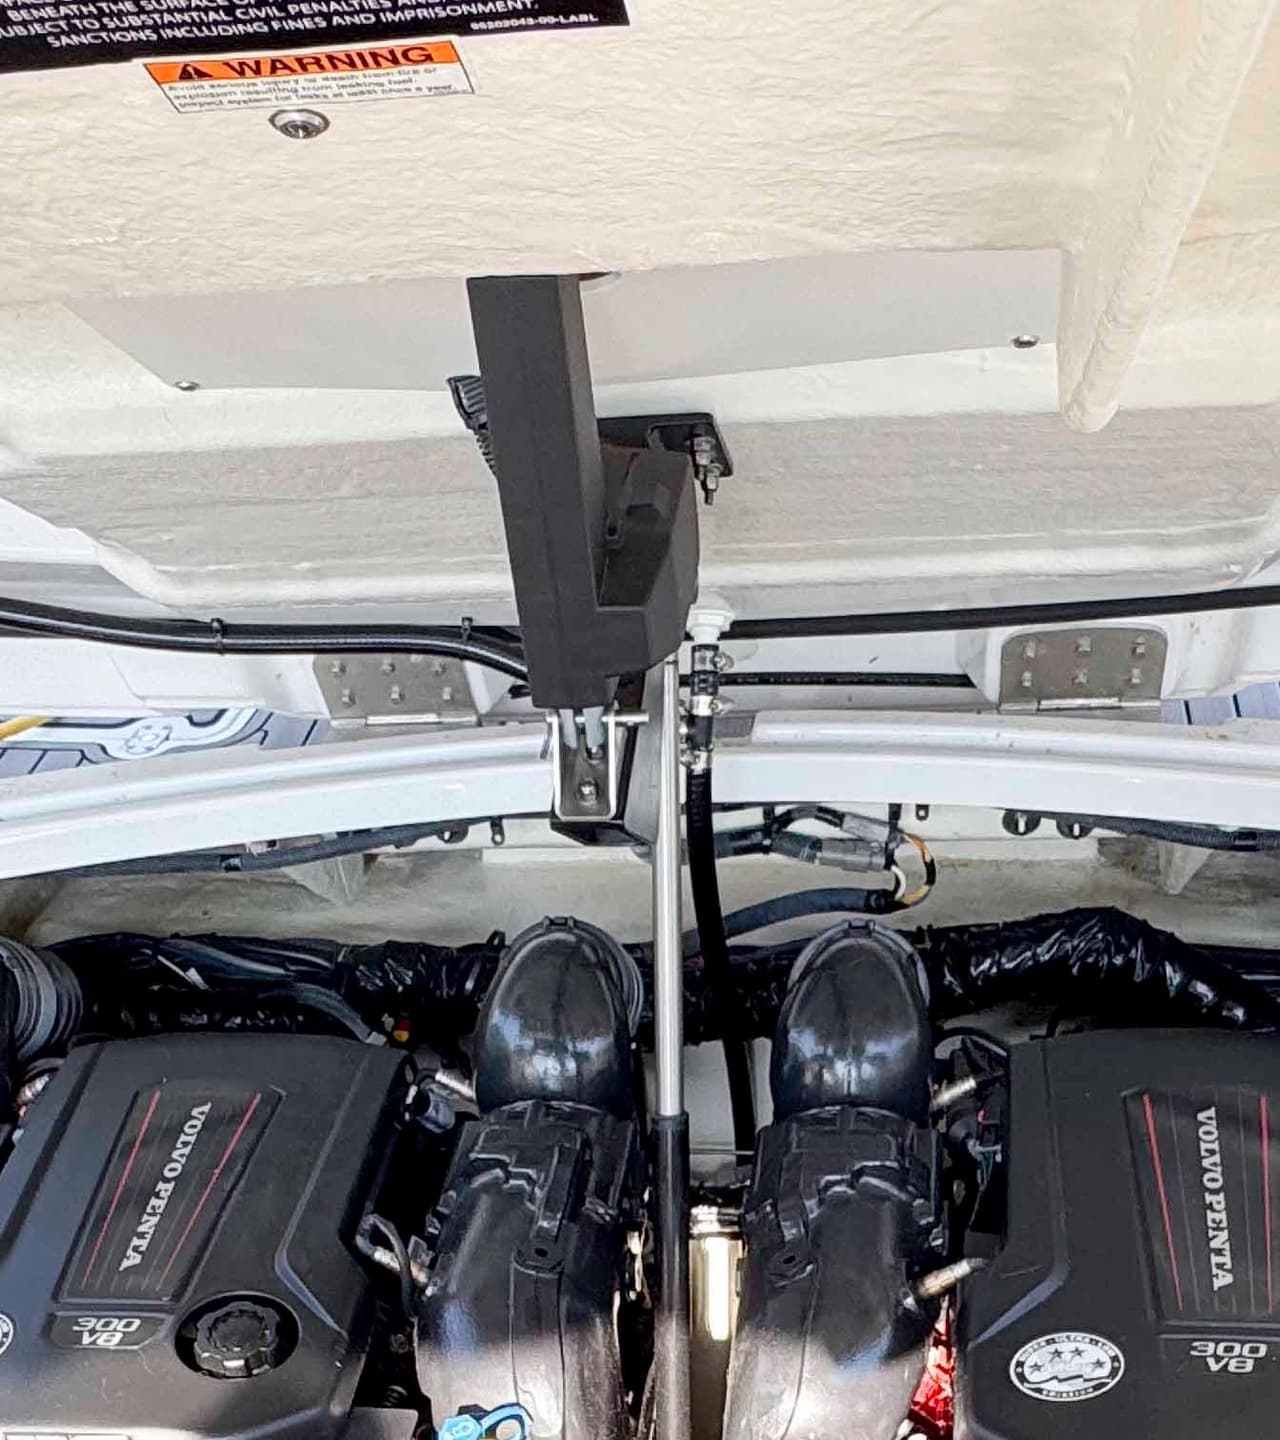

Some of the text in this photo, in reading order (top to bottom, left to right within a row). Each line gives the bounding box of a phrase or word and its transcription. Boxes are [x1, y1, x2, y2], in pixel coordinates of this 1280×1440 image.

[6, 3, 98, 21] BENEATH
[96, 0, 138, 13] THE
[71, 18, 100, 30] TO
[101, 10, 233, 29] SUBSTANTIAL
[235, 6, 287, 19] CIVIL
[287, 0, 393, 15] PENALTIES
[46, 0, 538, 48] SANCTIONS INCLUDING FINES AND IMPRISONMENT.
[221, 46, 434, 77] WARNING
[118, 1100, 212, 1272] VOLVO PENTA
[1196, 1106, 1234, 1292] VOLVO PENTA
[72, 1316, 141, 1332] 300
[81, 1331, 124, 1346] V8
[1189, 1341, 1268, 1358] 300
[1206, 1356, 1255, 1373] V8
